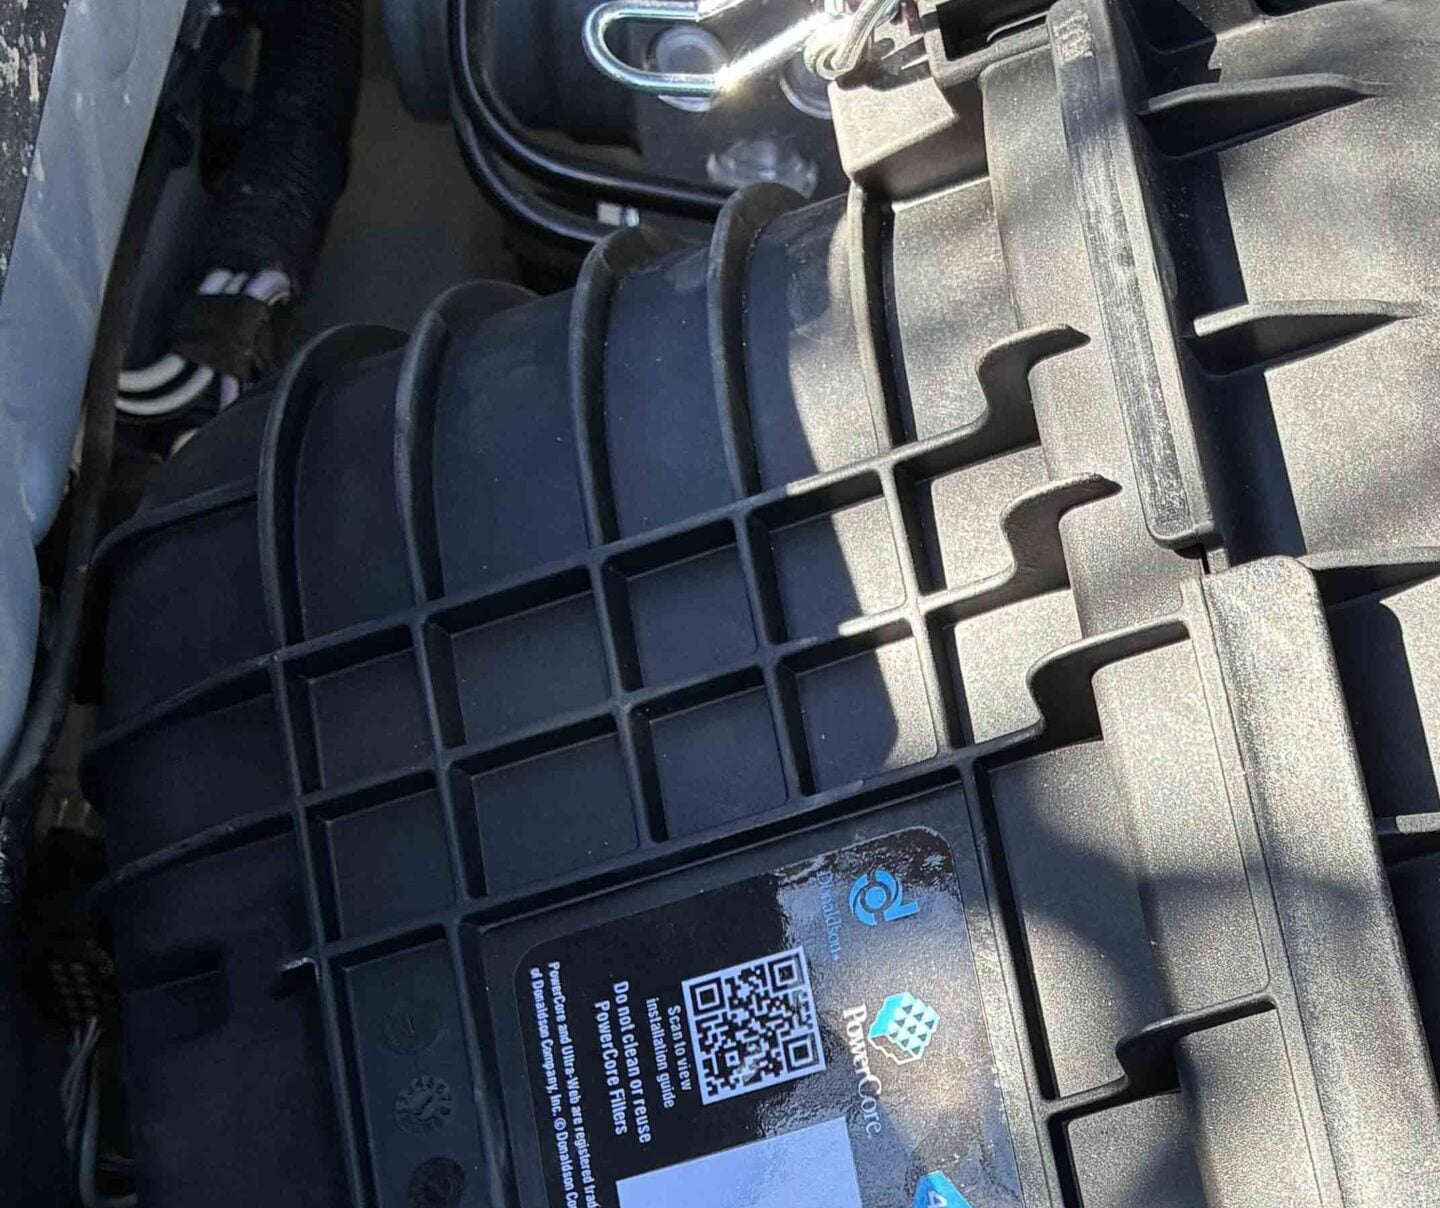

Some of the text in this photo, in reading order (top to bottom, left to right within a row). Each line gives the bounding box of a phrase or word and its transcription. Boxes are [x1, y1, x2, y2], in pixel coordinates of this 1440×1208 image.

[549, 962, 566, 1022] PowerCore
[558, 1024, 572, 1044] and
[595, 1001, 627, 1134] PowerCore Filters
[614, 981, 651, 1143] Do not clean or reuse
[647, 998, 676, 1108] installation guide
[668, 1005, 691, 1090] Scan to view
[532, 980, 549, 1038] Donaldson
[541, 1039, 558, 1093] Company,
[550, 1094, 561, 1116] Inc.
[556, 1132, 574, 1191] Donaldson
[562, 1046, 581, 1104] Ultra-Web
[571, 1106, 582, 1125] are
[574, 1127, 594, 1183] registered
